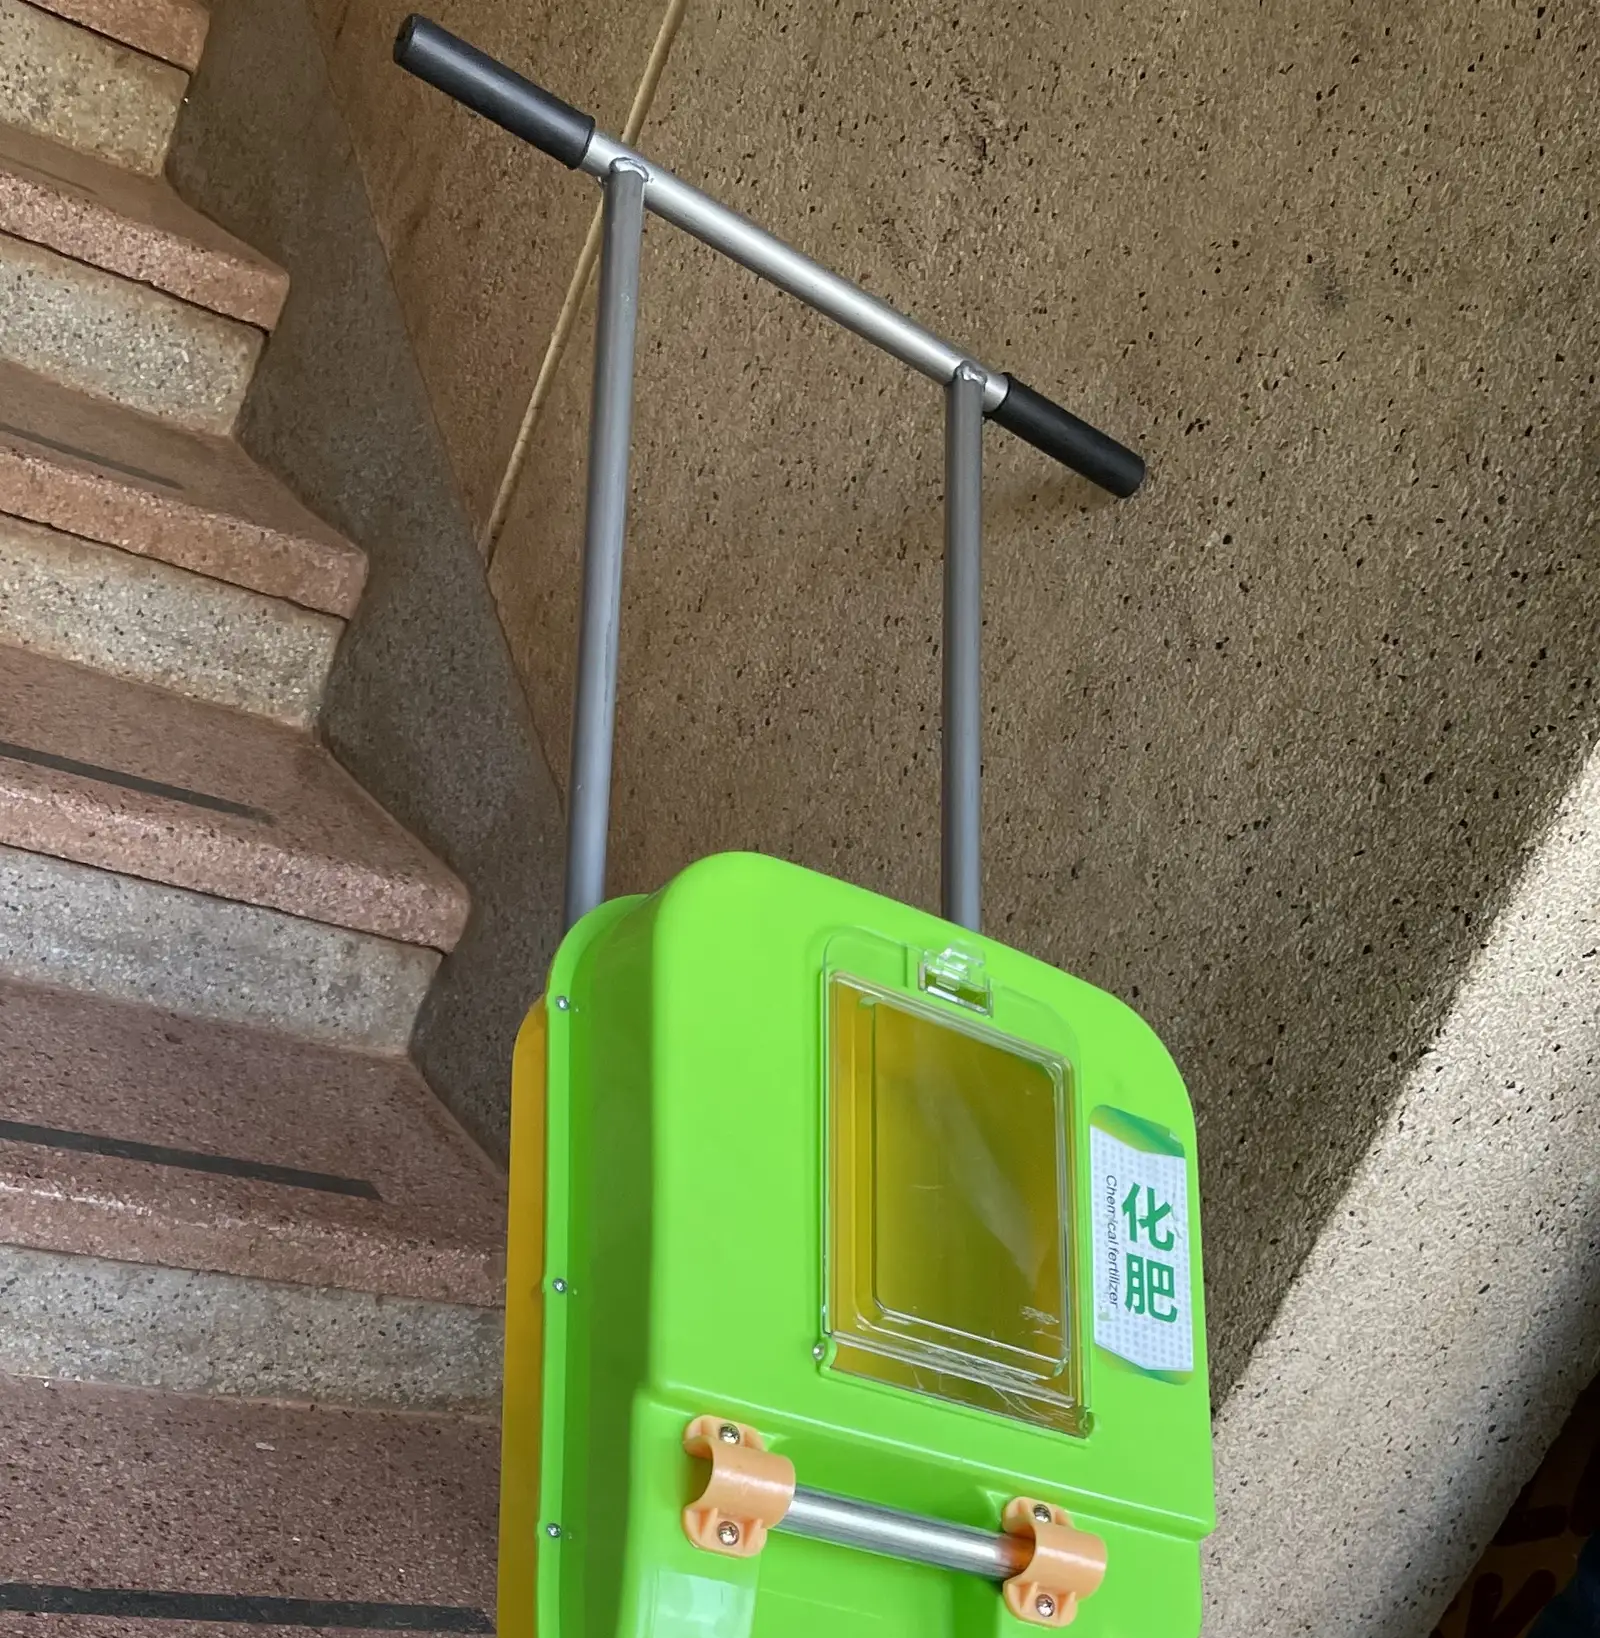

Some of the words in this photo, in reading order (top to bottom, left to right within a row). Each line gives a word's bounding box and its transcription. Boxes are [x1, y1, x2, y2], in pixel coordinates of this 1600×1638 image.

[1105, 1174, 1119, 1245] Chemical
[1108, 1247, 1121, 1307] fertilizer
[1121, 1182, 1178, 1323] 化肥
